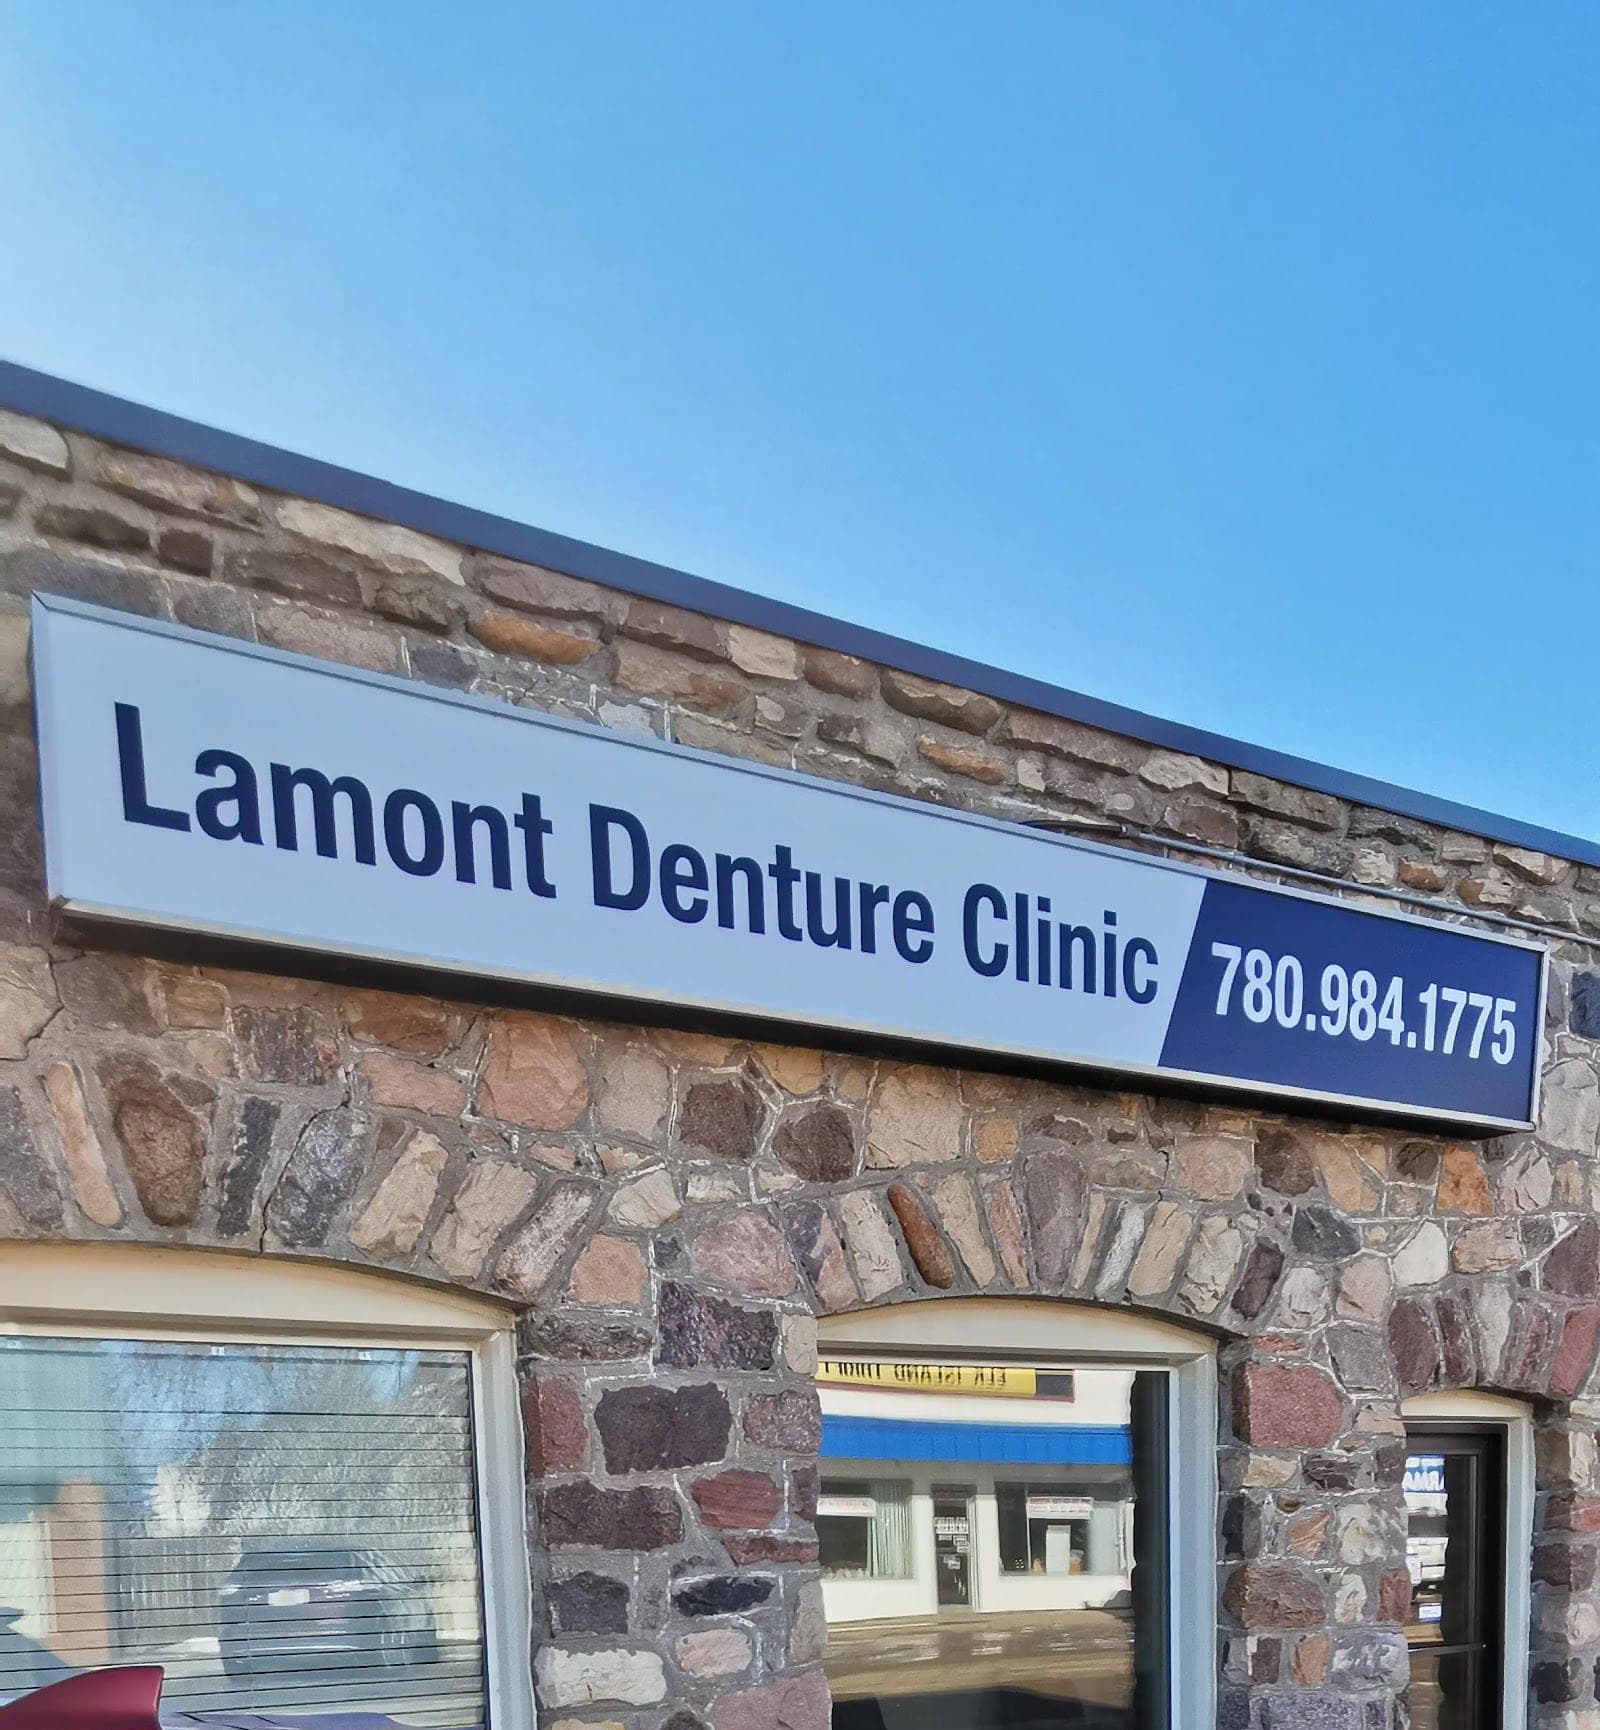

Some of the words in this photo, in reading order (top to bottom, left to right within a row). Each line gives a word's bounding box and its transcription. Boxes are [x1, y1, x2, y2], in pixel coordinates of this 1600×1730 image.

[114, 701, 557, 899] Lamont
[588, 803, 936, 964] Denture
[963, 883, 1159, 1005] Clinic
[1210, 941, 1517, 1065] 780.984.1775
